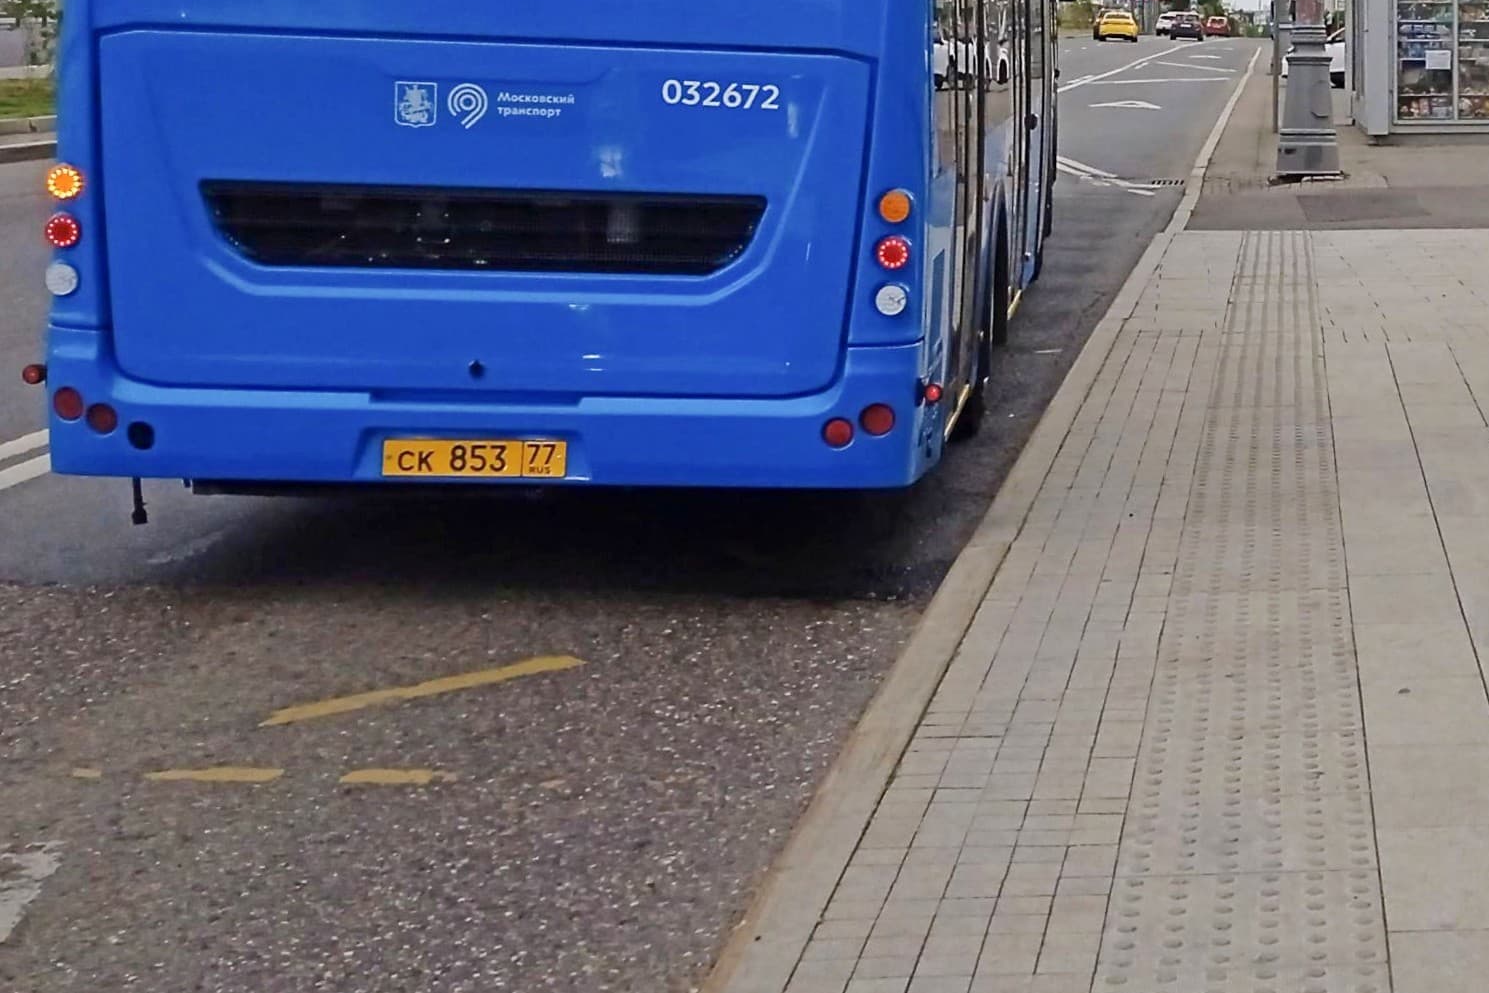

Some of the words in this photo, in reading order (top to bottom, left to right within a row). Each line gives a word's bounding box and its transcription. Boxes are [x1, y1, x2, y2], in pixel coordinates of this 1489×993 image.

[497, 92, 575, 104] Московский
[662, 78, 780, 110] 032672
[497, 107, 561, 118] транспорт
[449, 444, 508, 472] 853
[527, 444, 556, 465] 77
[529, 466, 551, 475] RUS
